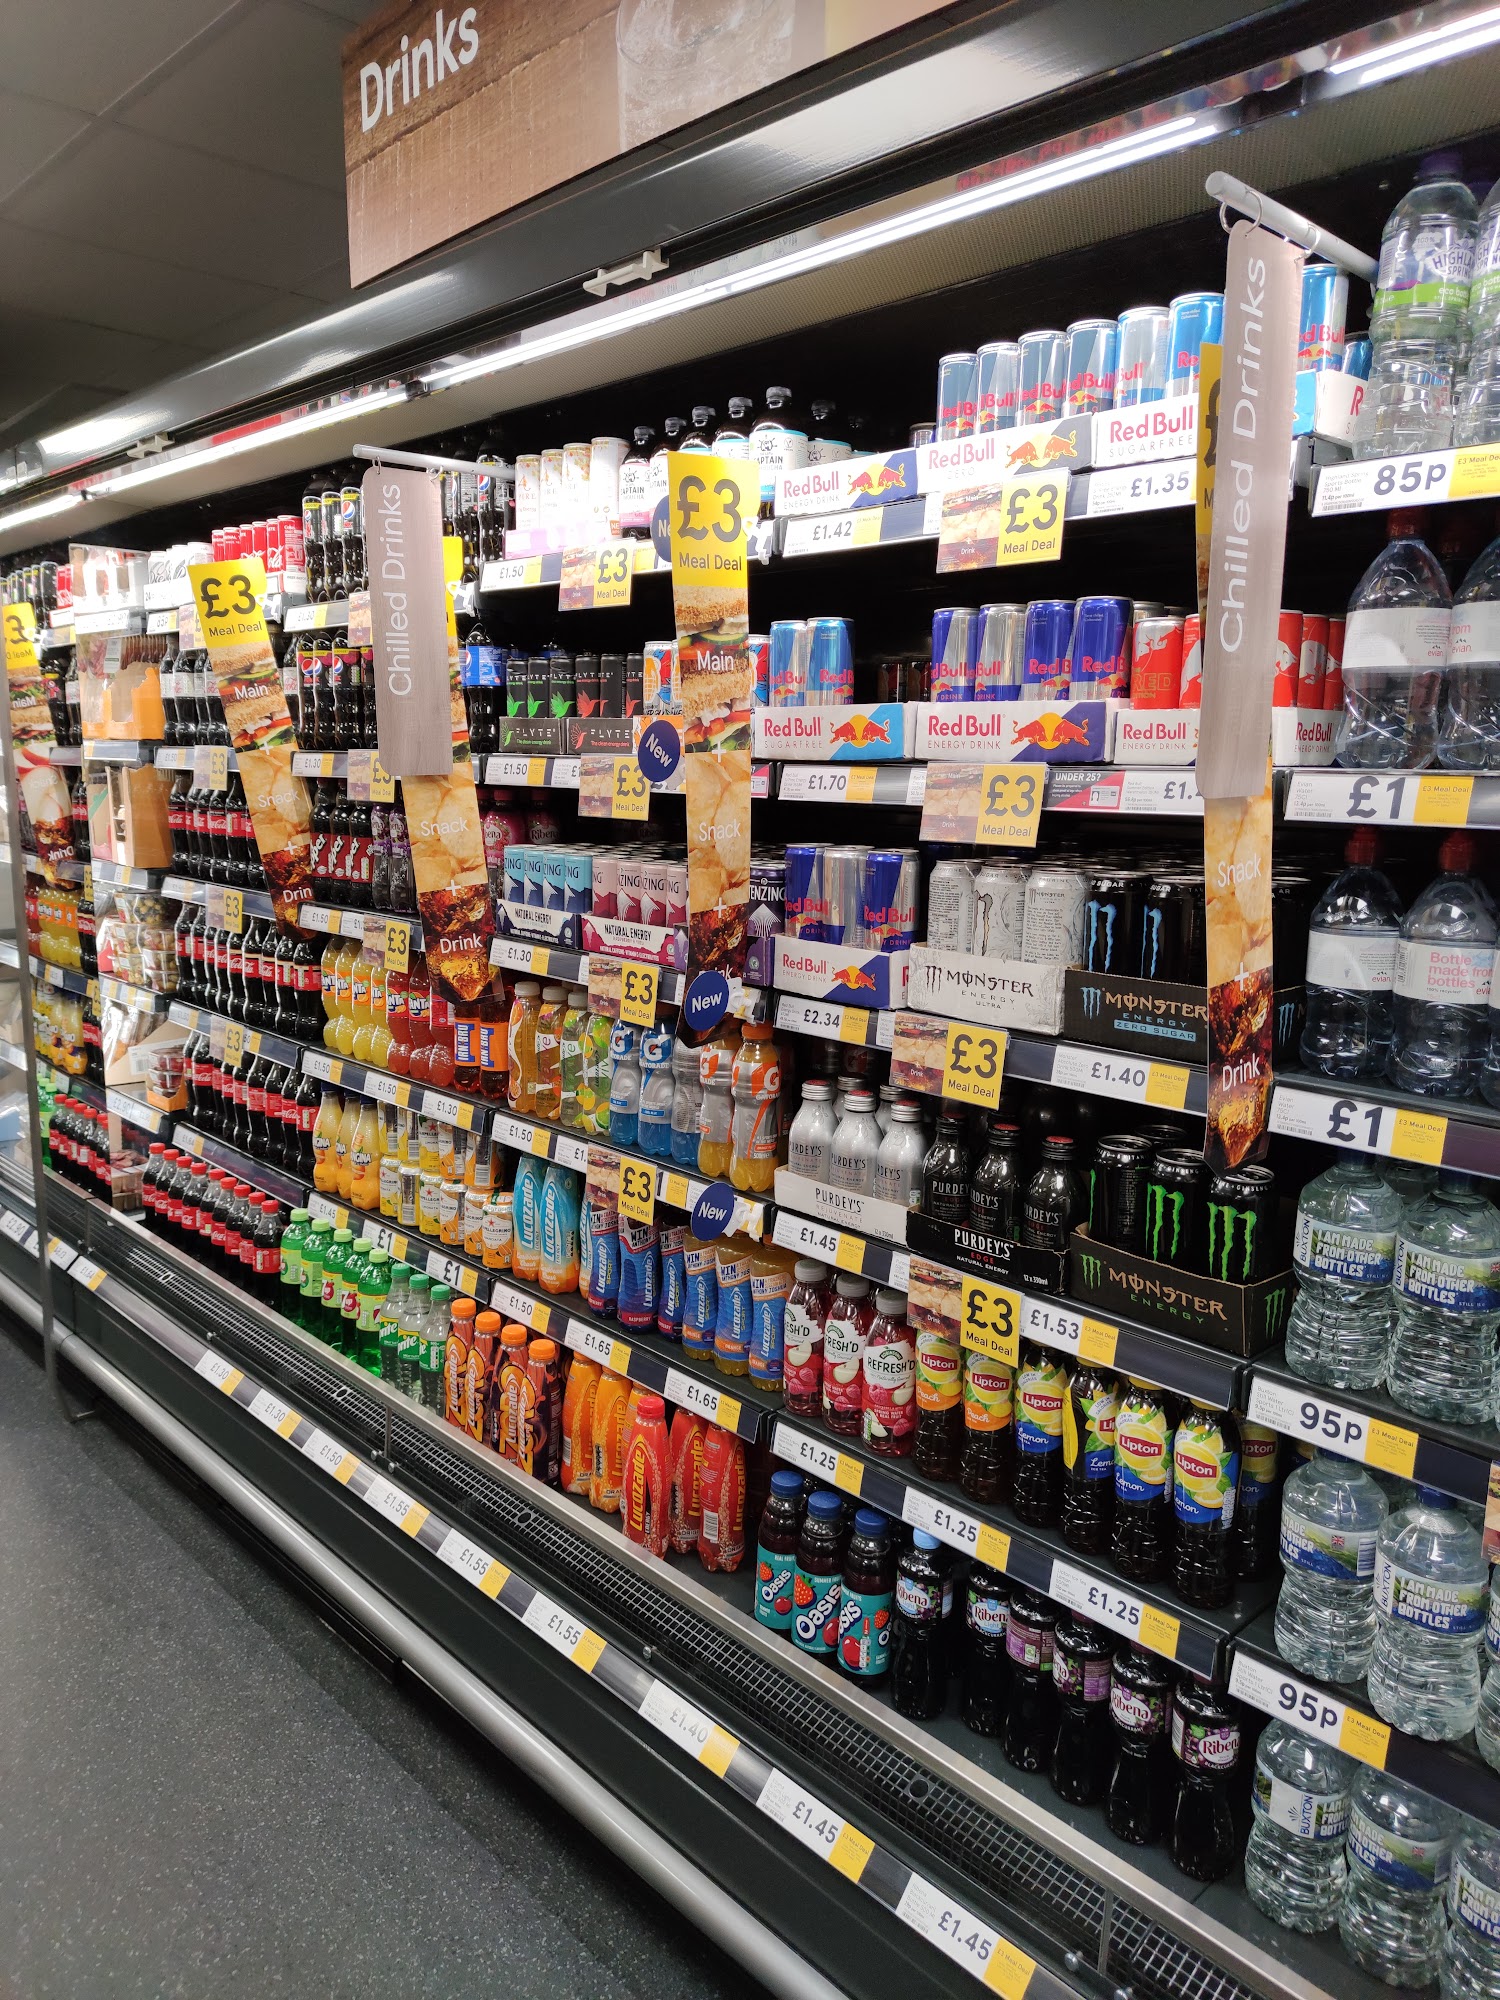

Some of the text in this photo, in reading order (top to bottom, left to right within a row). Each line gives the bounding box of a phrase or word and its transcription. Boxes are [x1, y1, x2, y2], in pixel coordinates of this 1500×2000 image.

[360, 6, 480, 133] Drinks
[1110, 405, 1193, 443] Red Bull
[929, 438, 995, 469] Red Bull
[1109, 434, 1193, 458] SUGARFREE
[1220, 256, 1266, 652] Chilled Drinks
[783, 471, 839, 498] Red Bull
[1130, 470, 1189, 498] £1.35
[1373, 461, 1446, 495] 85p
[677, 475, 742, 543] £3
[1005, 484, 1058, 534] £3
[813, 521, 852, 542] £1.42
[1003, 538, 1055, 555] Meal Deal
[598, 548, 628, 584] £3
[679, 552, 742, 571] Meal Deal
[201, 574, 256, 620] £3
[378, 484, 412, 696] Chilled Drinks
[208, 620, 262, 638] Meal Deal
[697, 651, 734, 672] Main
[234, 685, 268, 701] Main
[764, 717, 821, 737] Red Bull
[928, 714, 1001, 736] Red Bull
[1123, 722, 1186, 740] Red Bull
[1296, 722, 1332, 743] Red Bull
[646, 733, 672, 767] New
[764, 740, 823, 749] SUGARFREE
[928, 740, 1001, 750] ENERGY DRINK
[1123, 742, 1186, 750] ENERGY DRINK
[503, 763, 528, 776] £1.50
[1055, 772, 1102, 782] UNDER 25?
[808, 775, 847, 791] £1.70
[258, 789, 299, 808] Snack
[985, 775, 1036, 817] £3
[1346, 776, 1406, 819] £1
[420, 817, 468, 837] Snack
[699, 819, 741, 842] Snack
[982, 824, 1031, 838] Meal Deal
[1217, 852, 1261, 889] Snack
[225, 895, 240, 918] £3
[387, 927, 407, 955] £3
[440, 933, 483, 955] Drink
[605, 924, 652, 942] NATURAL ENERGY
[508, 948, 532, 962] £1.30
[783, 953, 827, 974] Red Bull
[1430, 952, 1472, 966] Bottle
[1427, 975, 1475, 989] bottles
[1429, 964, 1469, 978] made
[625, 970, 653, 1005] £3
[961, 989, 1015, 1005] ENERGY
[692, 992, 722, 1013] New
[975, 1001, 1002, 1010] ULTRA
[804, 1009, 840, 1027] £2.34
[1123, 1012, 1188, 1028] ENERGY
[227, 1028, 241, 1050] £3
[1116, 1021, 1195, 1041] ZERO SUGAR
[314, 1060, 330, 1074] £1.50
[950, 1034, 997, 1079] £3
[1091, 1061, 1146, 1087] £1.40
[1222, 1053, 1261, 1092] Drink
[378, 1081, 396, 1095] £1.50
[948, 1078, 994, 1098] Meal Deal
[437, 1098, 457, 1115] £1.30
[509, 1126, 532, 1143] £1.50
[1327, 1100, 1383, 1148] £1
[622, 1167, 651, 1203] £3
[698, 1202, 727, 1221] New
[815, 1187, 862, 1213] PURDEY'S
[521, 1179, 535, 1249] Lucozade
[378, 1229, 393, 1249] £1
[800, 1227, 836, 1251] £1.45
[954, 1229, 1010, 1258] PURDEY'S
[1300, 1217, 1311, 1263] BUXTON
[1341, 1233, 1374, 1251] MADE
[595, 1244, 606, 1294] Lucozade
[957, 1255, 1009, 1275] NATURAL ENERGY
[970, 1251, 995, 1264] EDGE
[1314, 1256, 1365, 1278] BOTTLES
[1394, 1240, 1405, 1288] BUXTON
[1433, 1258, 1465, 1278] MADE
[443, 1260, 460, 1286] £1
[720, 1263, 736, 1276] WIN
[665, 1264, 675, 1316] Lucozade
[1408, 1281, 1456, 1305] BOTTLES
[510, 1296, 532, 1316] £1.50
[696, 1280, 705, 1328] Lucozade
[967, 1288, 1013, 1337] £3
[1130, 1293, 1205, 1325] ENERGY
[731, 1294, 742, 1339] Lucozade
[1030, 1308, 1079, 1340] £1.53
[585, 1335, 610, 1356] £1.65
[965, 1332, 1013, 1357] Meal Deal
[211, 1361, 230, 1380] £1.30
[868, 1356, 915, 1374] REFRESH'D
[922, 1355, 955, 1370] Lipton
[450, 1354, 459, 1412] Lucozade
[974, 1374, 1007, 1390] Lipton
[687, 1387, 717, 1411] £1.65
[1025, 1395, 1062, 1409] Lipton
[265, 1402, 286, 1422] £1.30
[1300, 1402, 1362, 1444] 95p
[1018, 1425, 1049, 1445] Lemon
[1121, 1436, 1159, 1455] Lipton
[320, 1444, 343, 1466] £1.50
[800, 1442, 836, 1471] £1.25
[1177, 1454, 1213, 1477] Lipton
[630, 1448, 645, 1532] Lucozade
[384, 1491, 410, 1517] £1.55
[934, 1510, 977, 1543] £1.25
[460, 1548, 489, 1577] £1.55
[762, 1570, 792, 1601] Oasis
[1381, 1561, 1393, 1608] BUXTON
[1426, 1584, 1459, 1603] MADE
[796, 1584, 841, 1639] Oasis
[1087, 1586, 1140, 1626] £1.25
[1397, 1602, 1450, 1629] BOTTLES
[547, 1614, 582, 1645] £1.55
[1111, 1690, 1150, 1720] Ribena
[1278, 1682, 1338, 1730] 95p
[669, 1706, 709, 1743] £1.40
[1202, 1731, 1240, 1754] Ribena
[792, 1800, 839, 1844] £1.45
[1300, 1794, 1314, 1835] BUXTON
[938, 1910, 992, 1961] £1.45
[1018, 1961, 1031, 1976] Deal
